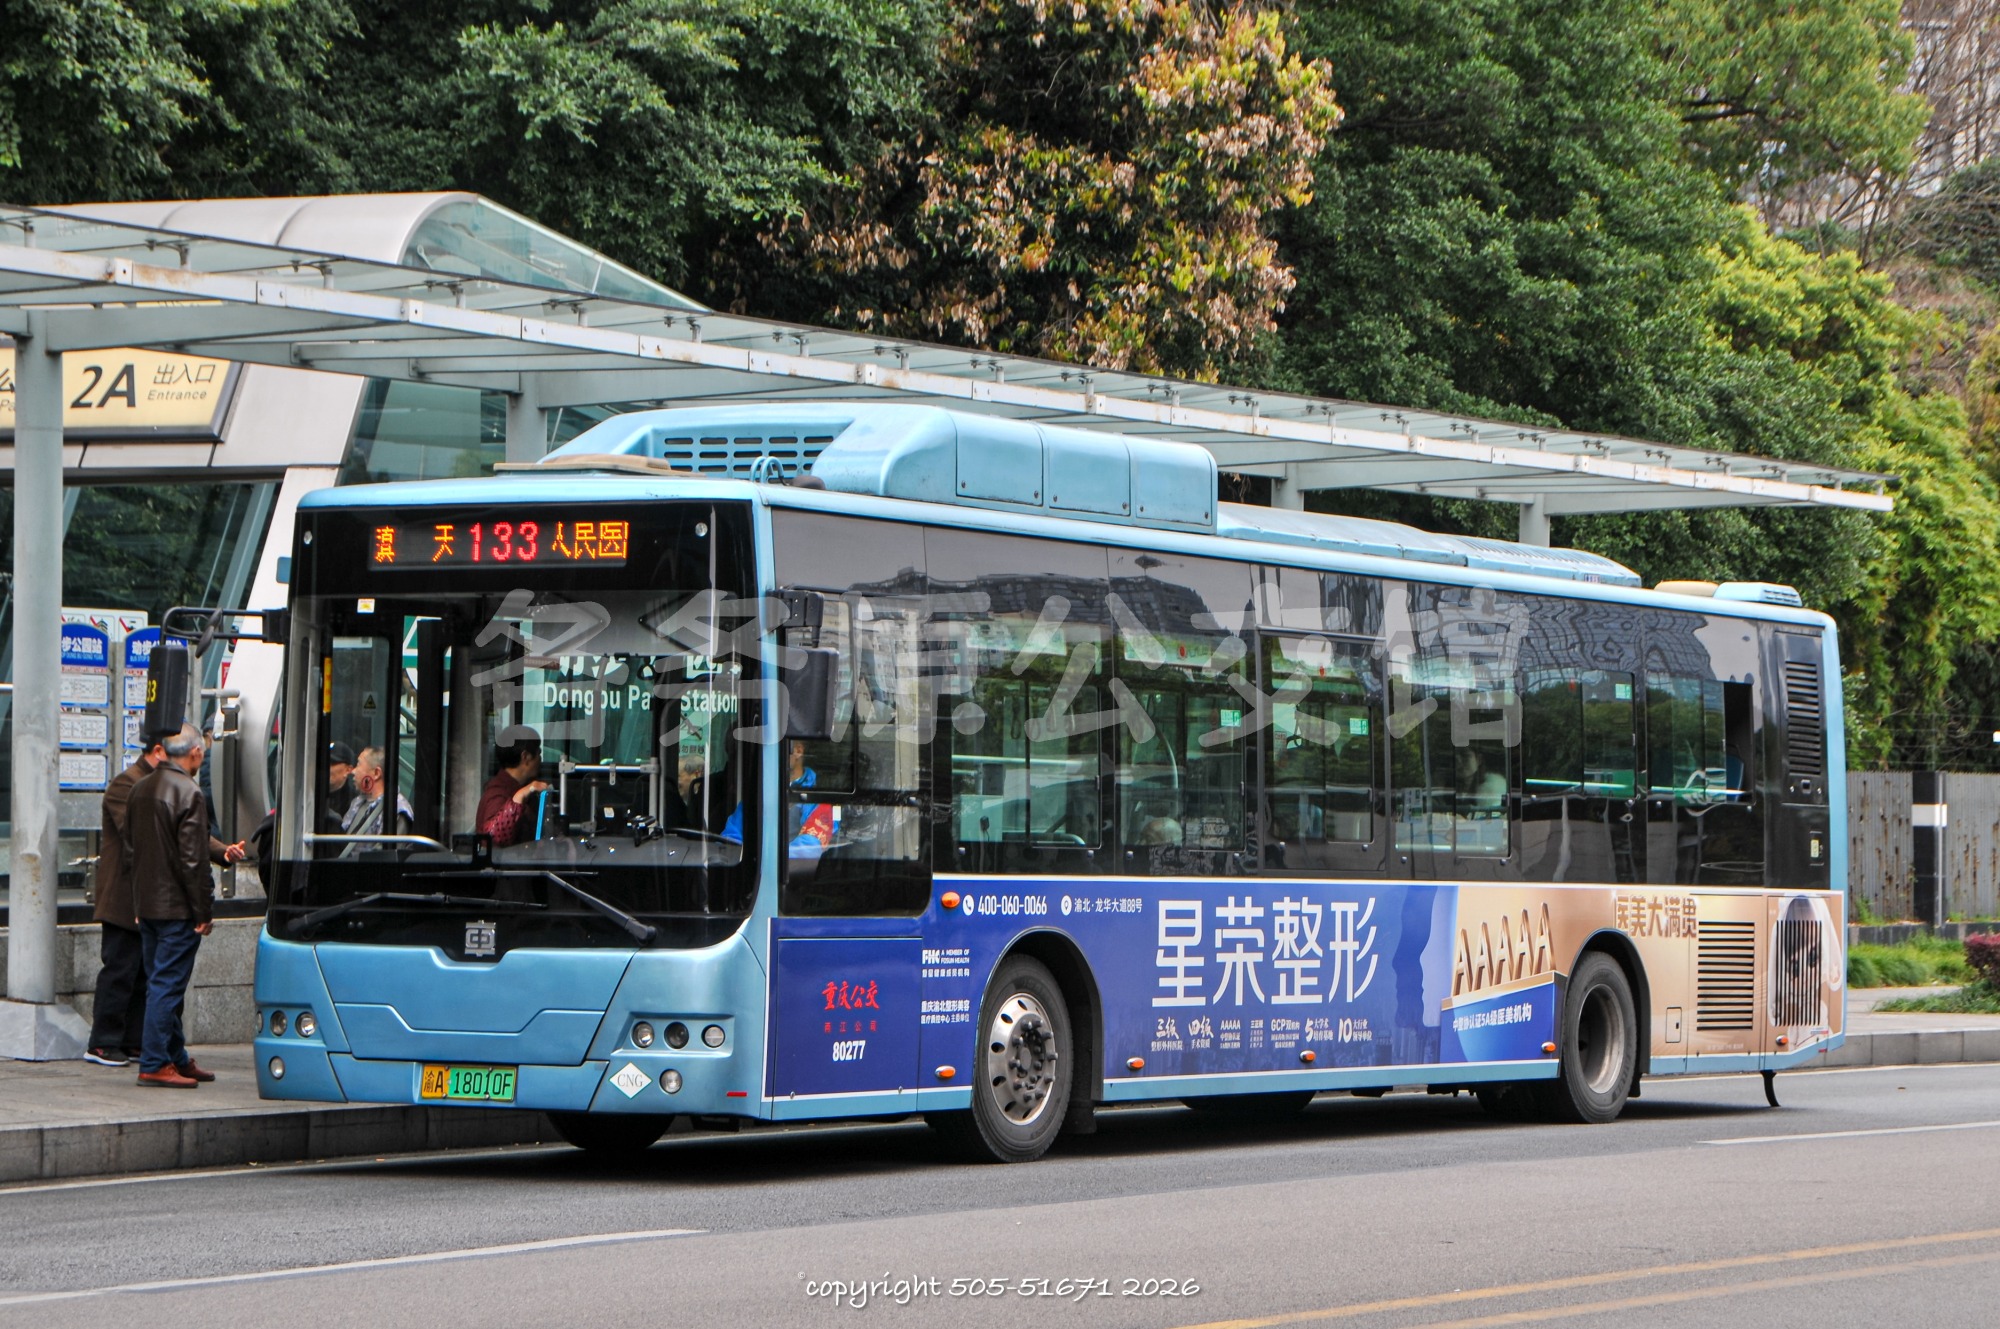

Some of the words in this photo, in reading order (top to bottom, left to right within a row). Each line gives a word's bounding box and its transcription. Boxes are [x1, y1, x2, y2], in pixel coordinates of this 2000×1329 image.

[70, 363, 136, 408] 2A
[153, 363, 216, 384] 出入口
[147, 390, 207, 401] Entrance
[470, 522, 538, 561] 133
[977, 895, 1047, 916] 400-060-0066
[1615, 895, 1698, 938] 医美大满贯
[1152, 896, 1379, 1007] 星荣整形
[1451, 902, 1557, 997] AAAAA
[822, 980, 879, 1011] 重庆公交
[824, 1020, 877, 1034] 两江公司
[1220, 1019, 1240, 1030] AAAAA
[1305, 1018, 1314, 1042] 5
[1338, 1018, 1353, 1043] 10
[832, 1040, 866, 1062] 80277
[424, 1070, 445, 1094] 渝A
[453, 1071, 513, 1097] 18010F
[616, 1073, 644, 1088] CNG
